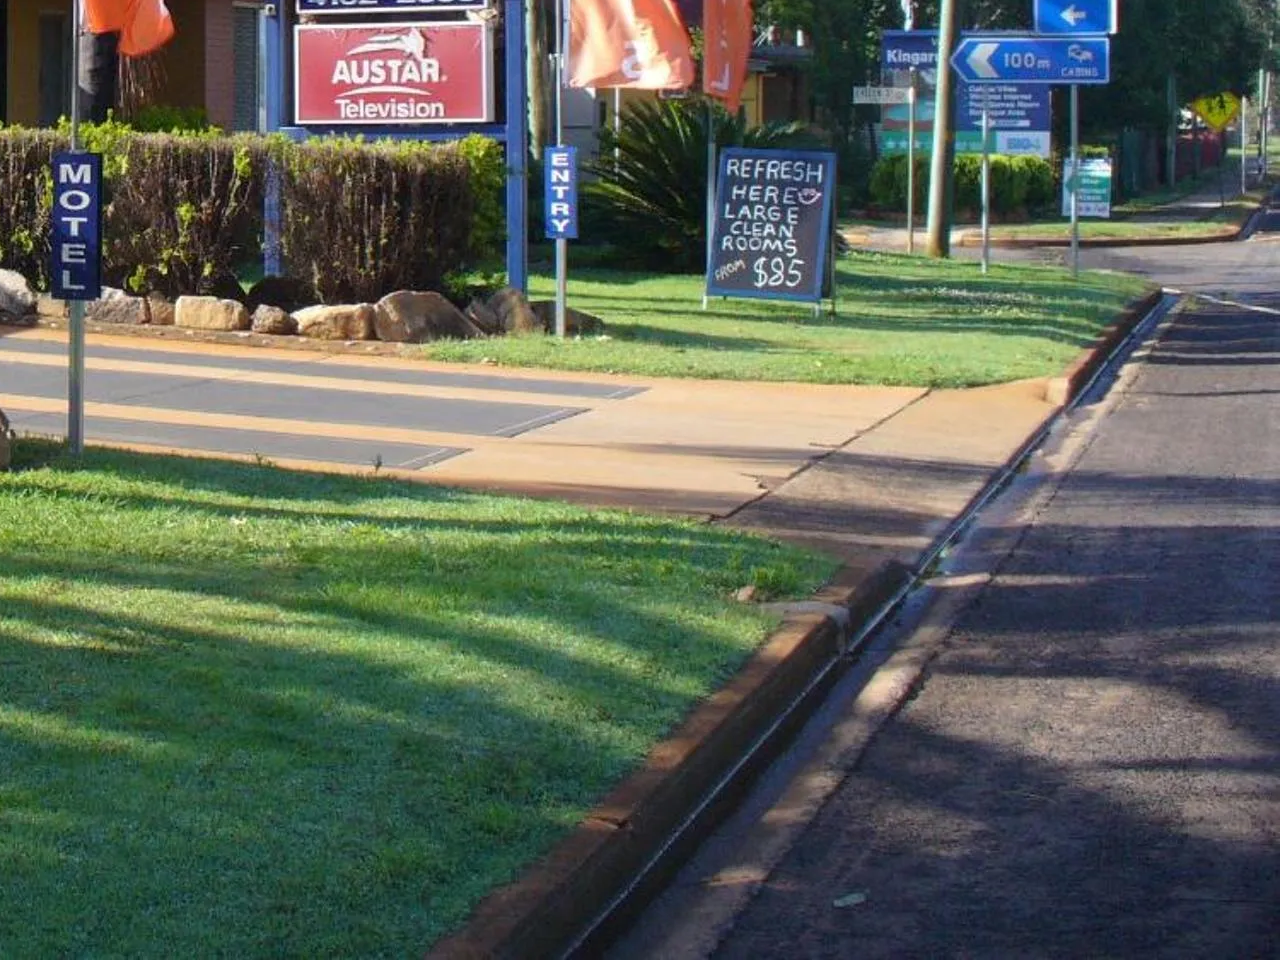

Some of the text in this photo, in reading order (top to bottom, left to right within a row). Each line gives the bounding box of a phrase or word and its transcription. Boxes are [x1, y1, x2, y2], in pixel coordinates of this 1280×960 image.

[331, 58, 441, 85] AUSTAR
[1061, 67, 1099, 78] CABINS
[334, 97, 445, 119] Television
[726, 158, 824, 185] REFRESH
[550, 152, 570, 233] ENTRY
[731, 184, 799, 205] HERE
[724, 203, 800, 226] LARGE
[59, 163, 92, 290] MOTEL
[730, 220, 795, 238] CLEAN
[721, 235, 799, 258] ROOMS
[714, 256, 806, 288] FROM $85
